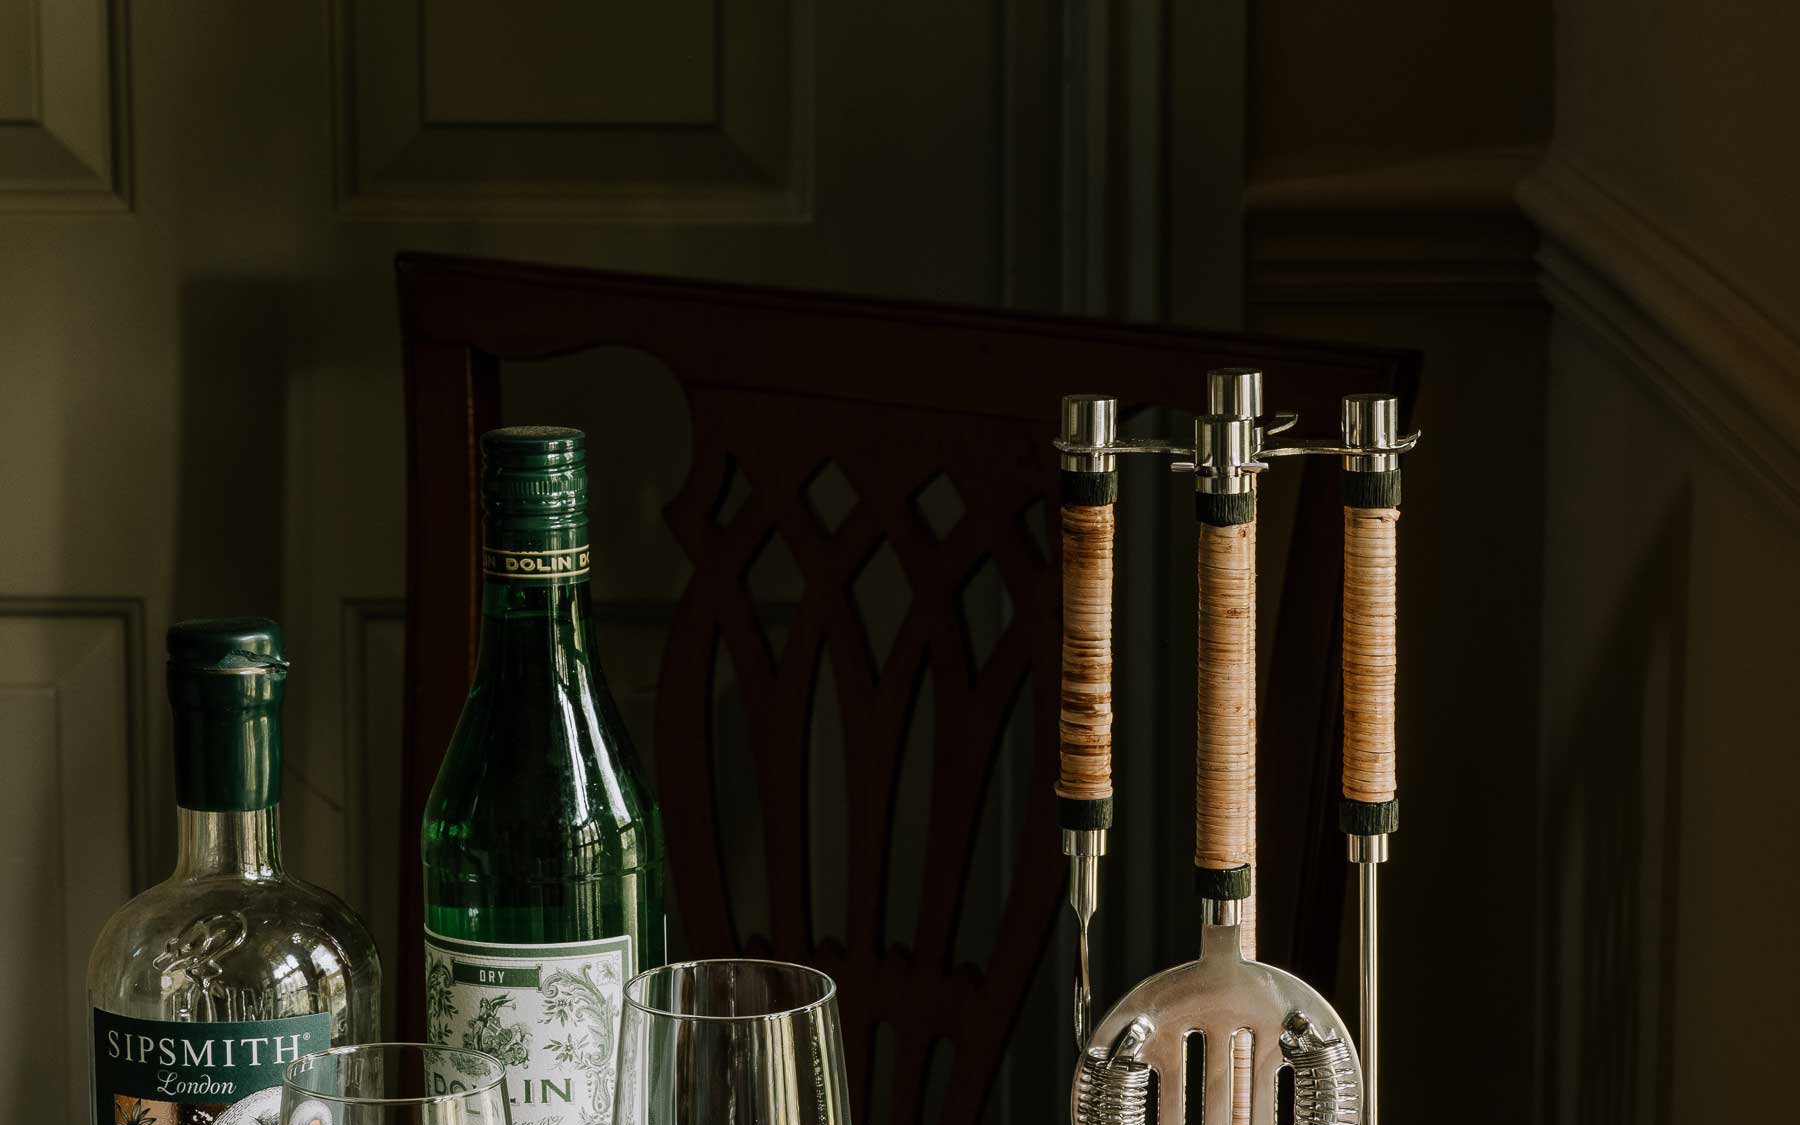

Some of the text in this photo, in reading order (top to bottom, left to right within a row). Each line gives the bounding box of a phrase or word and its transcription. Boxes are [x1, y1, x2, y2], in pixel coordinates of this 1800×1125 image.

[505, 556, 573, 572] DOLIN
[480, 970, 505, 984] DRY
[156, 1070, 237, 1096] London
